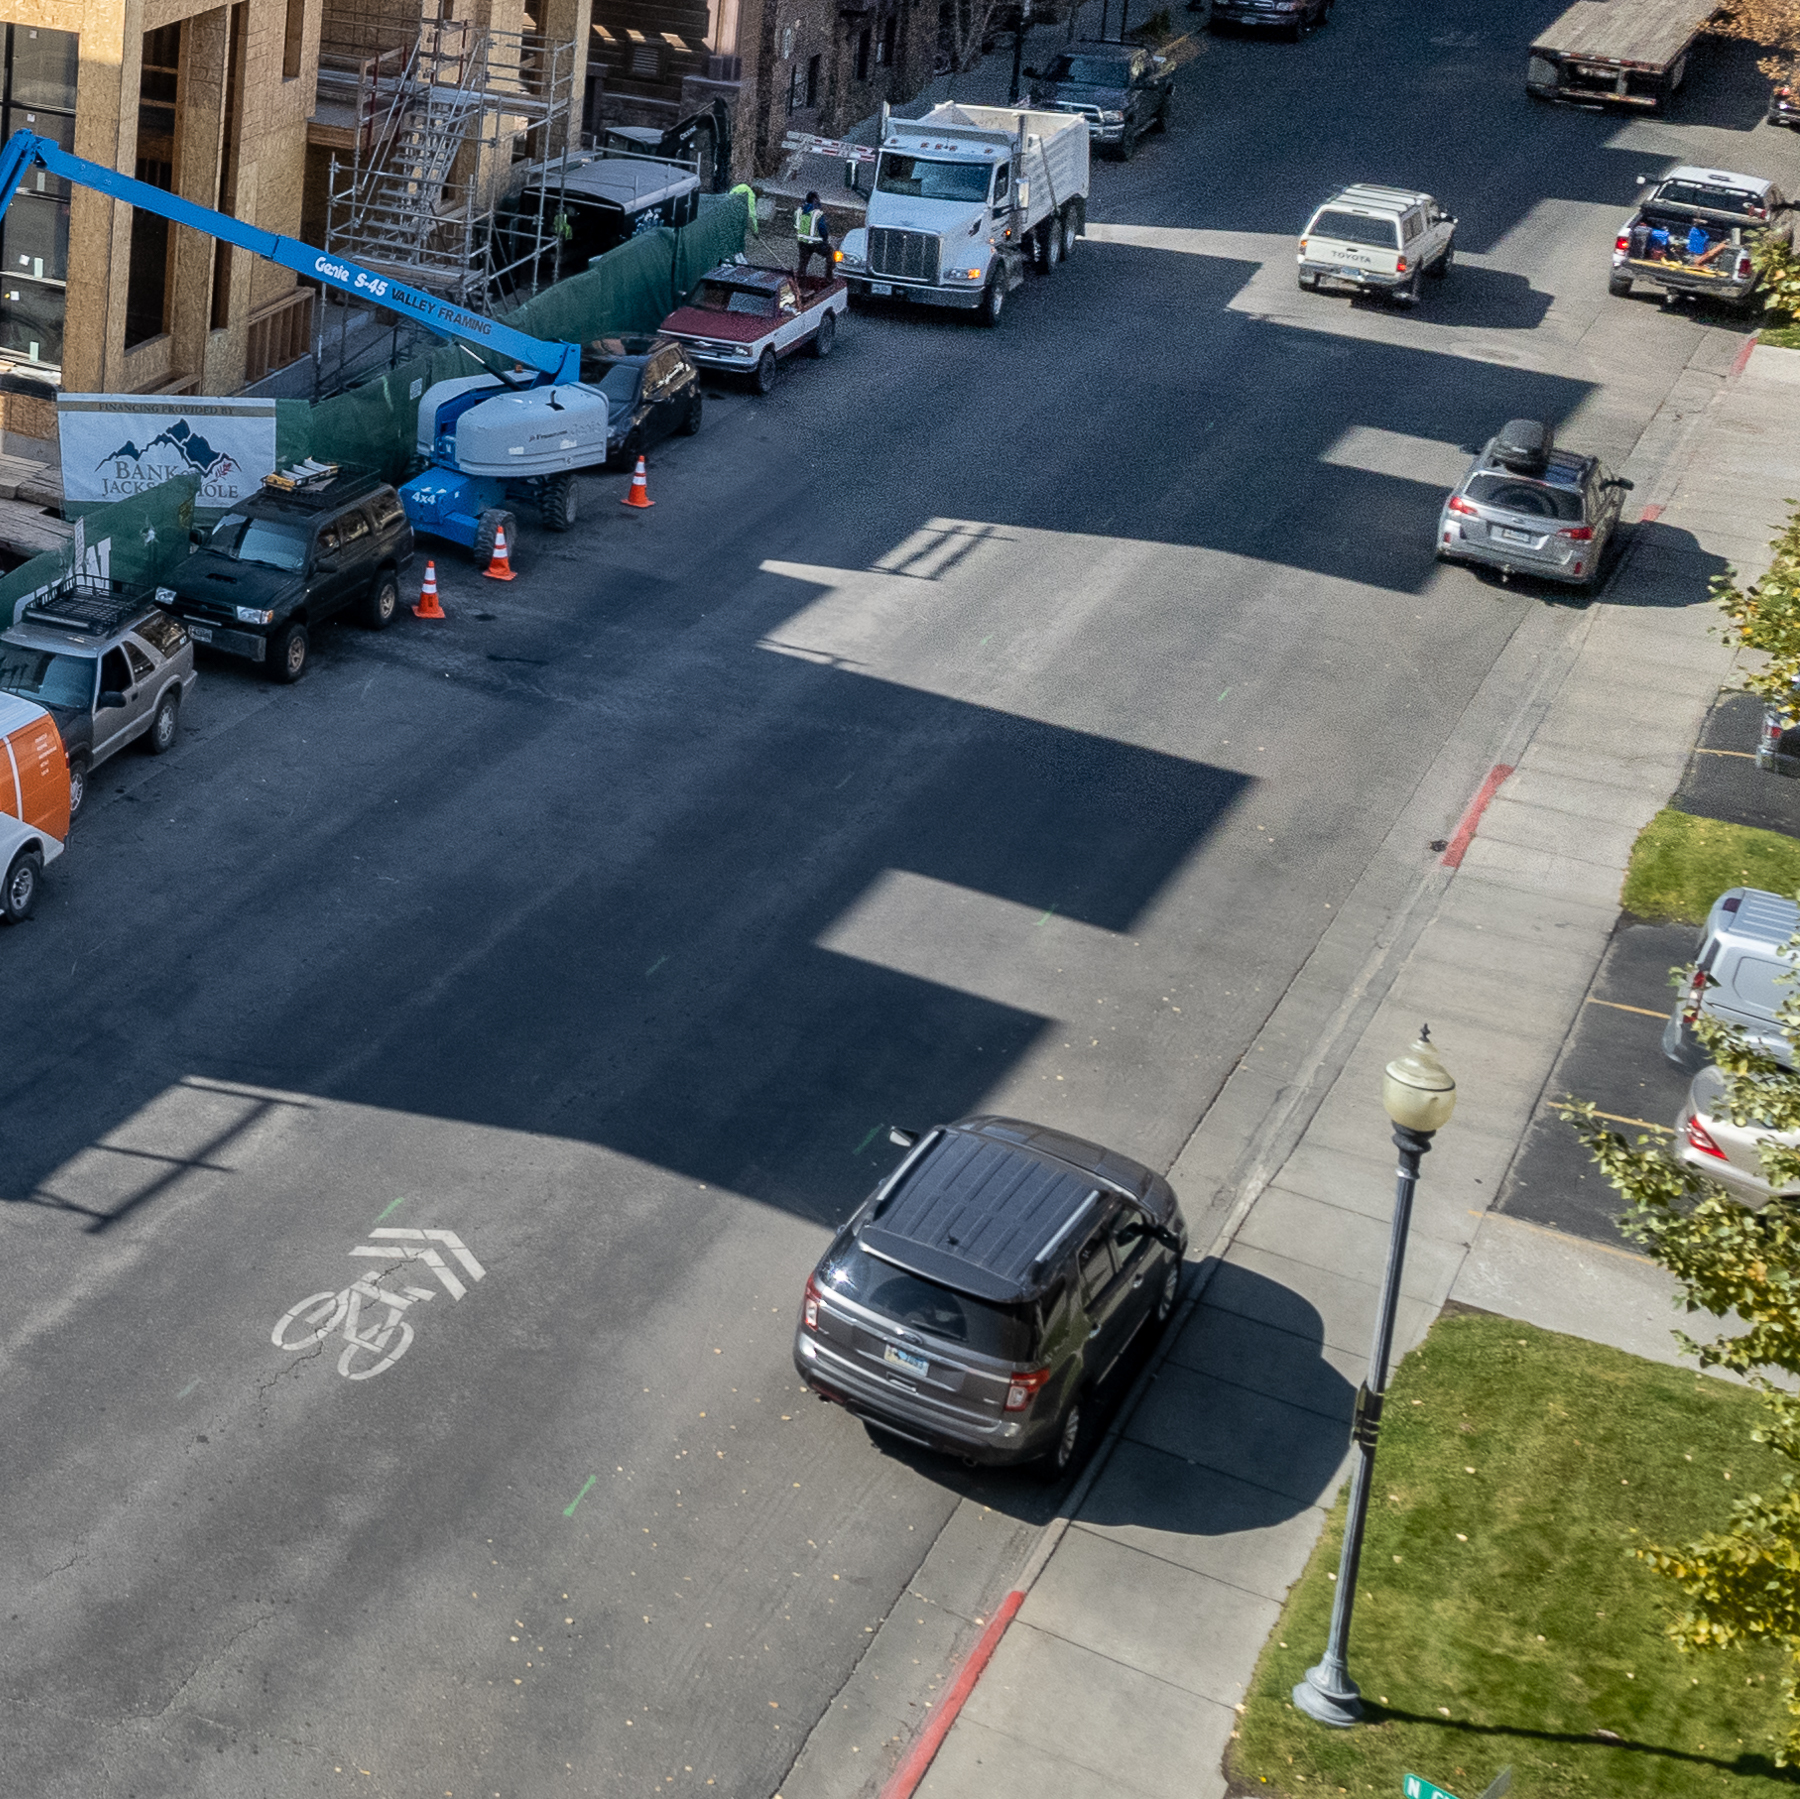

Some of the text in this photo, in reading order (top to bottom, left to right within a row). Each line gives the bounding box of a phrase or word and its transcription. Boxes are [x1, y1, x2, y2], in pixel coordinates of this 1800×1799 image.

[1331, 251, 1371, 263] TOYOTA
[314, 256, 492, 336] Genie S-45 VALLEY FRAMING
[101, 403, 236, 415] FINANCING PROVIDED BY
[115, 460, 178, 481] BANK
[102, 477, 156, 497] JACKS
[411, 491, 437, 505] 4x4
